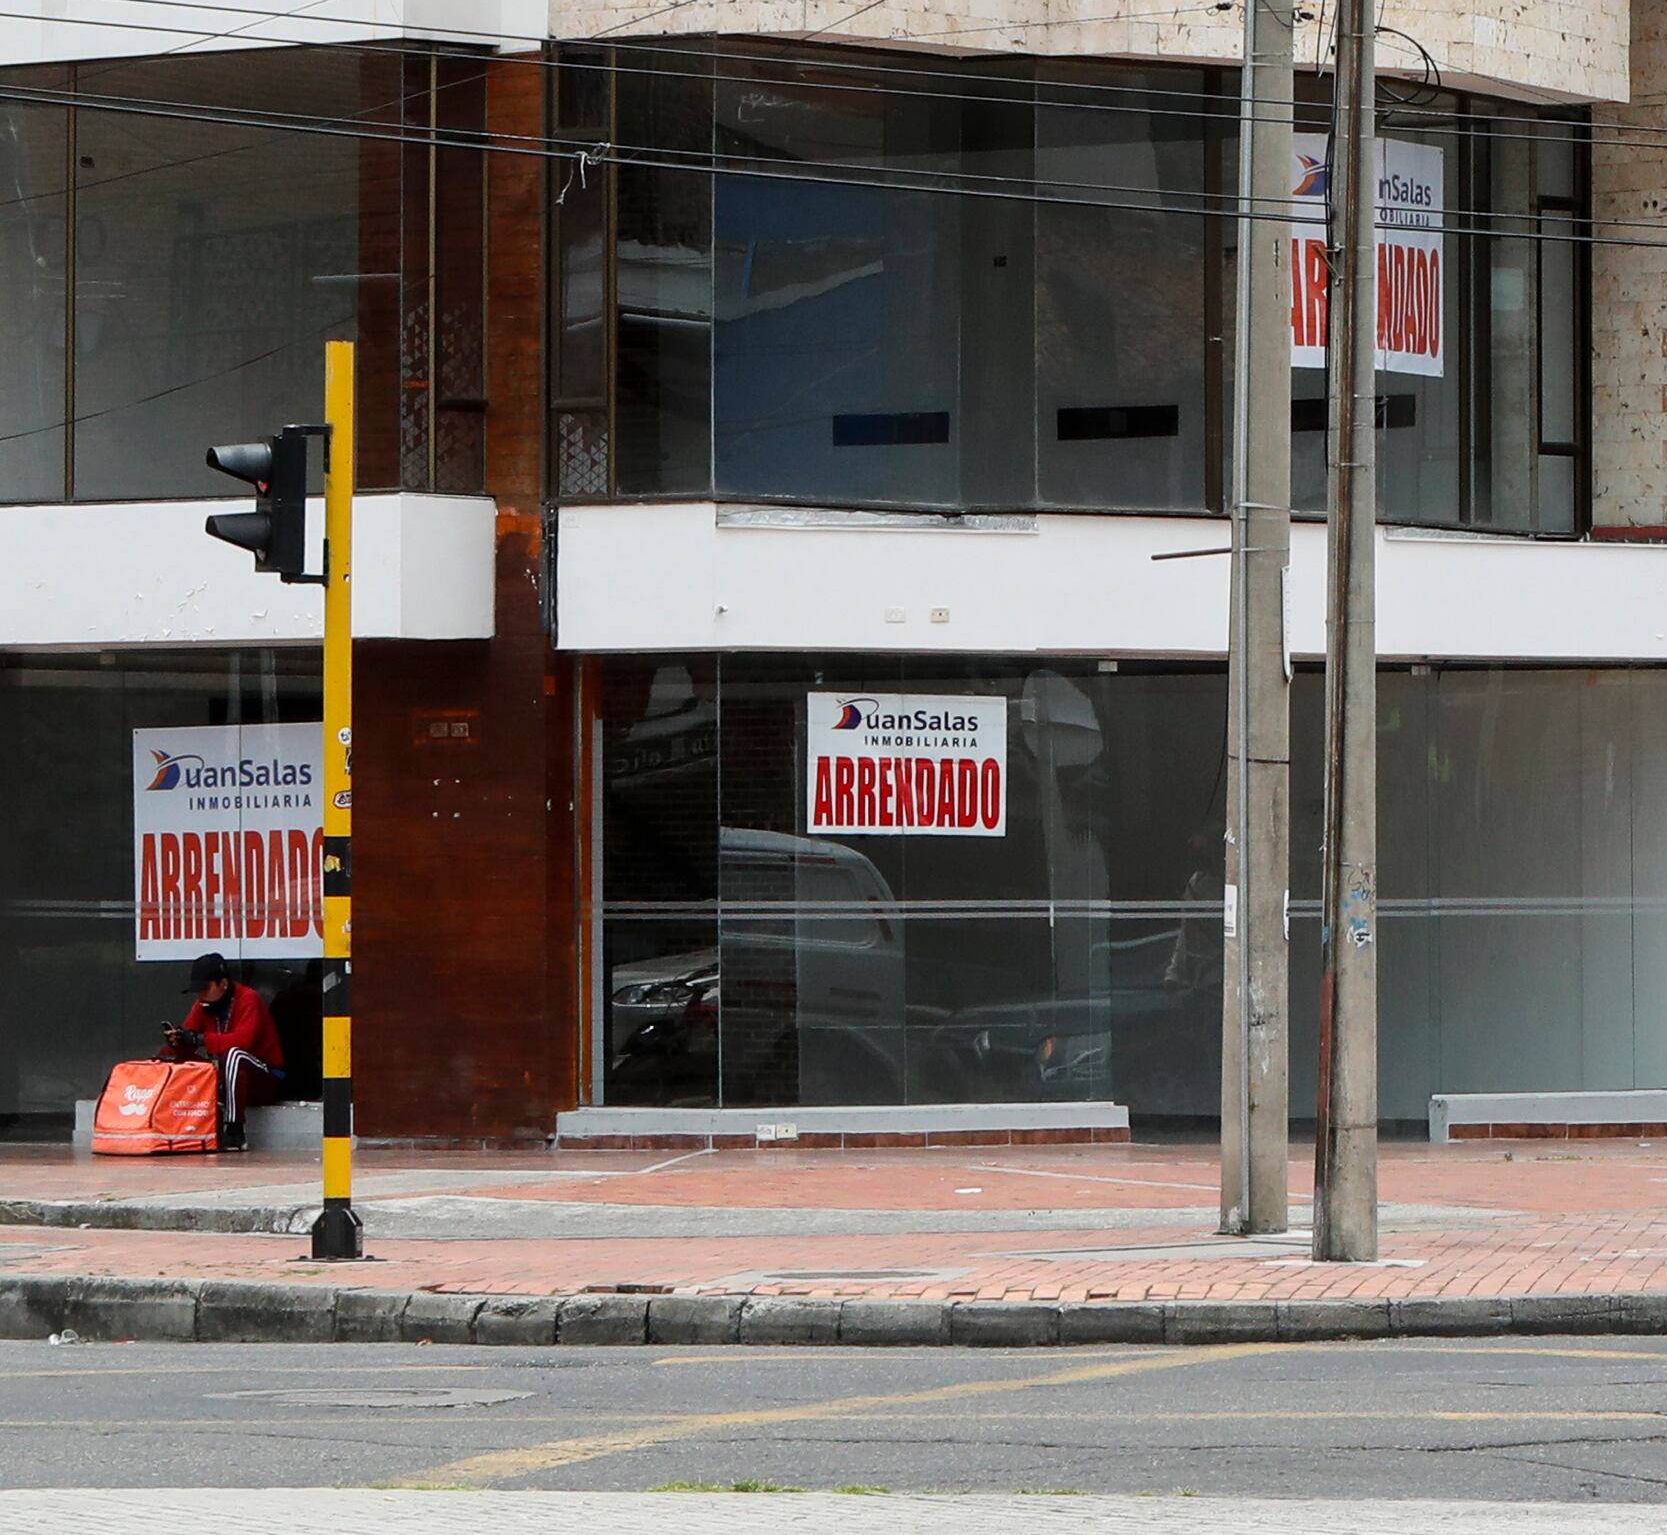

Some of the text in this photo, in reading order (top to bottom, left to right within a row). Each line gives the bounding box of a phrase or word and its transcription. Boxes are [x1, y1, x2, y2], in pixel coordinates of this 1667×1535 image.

[1291, 239, 1439, 358] ARNDADO
[864, 736, 978, 748] INMOBILIARIA
[189, 794, 312, 810] INMOBILIARIA
[813, 756, 1000, 829] ARRENDADO
